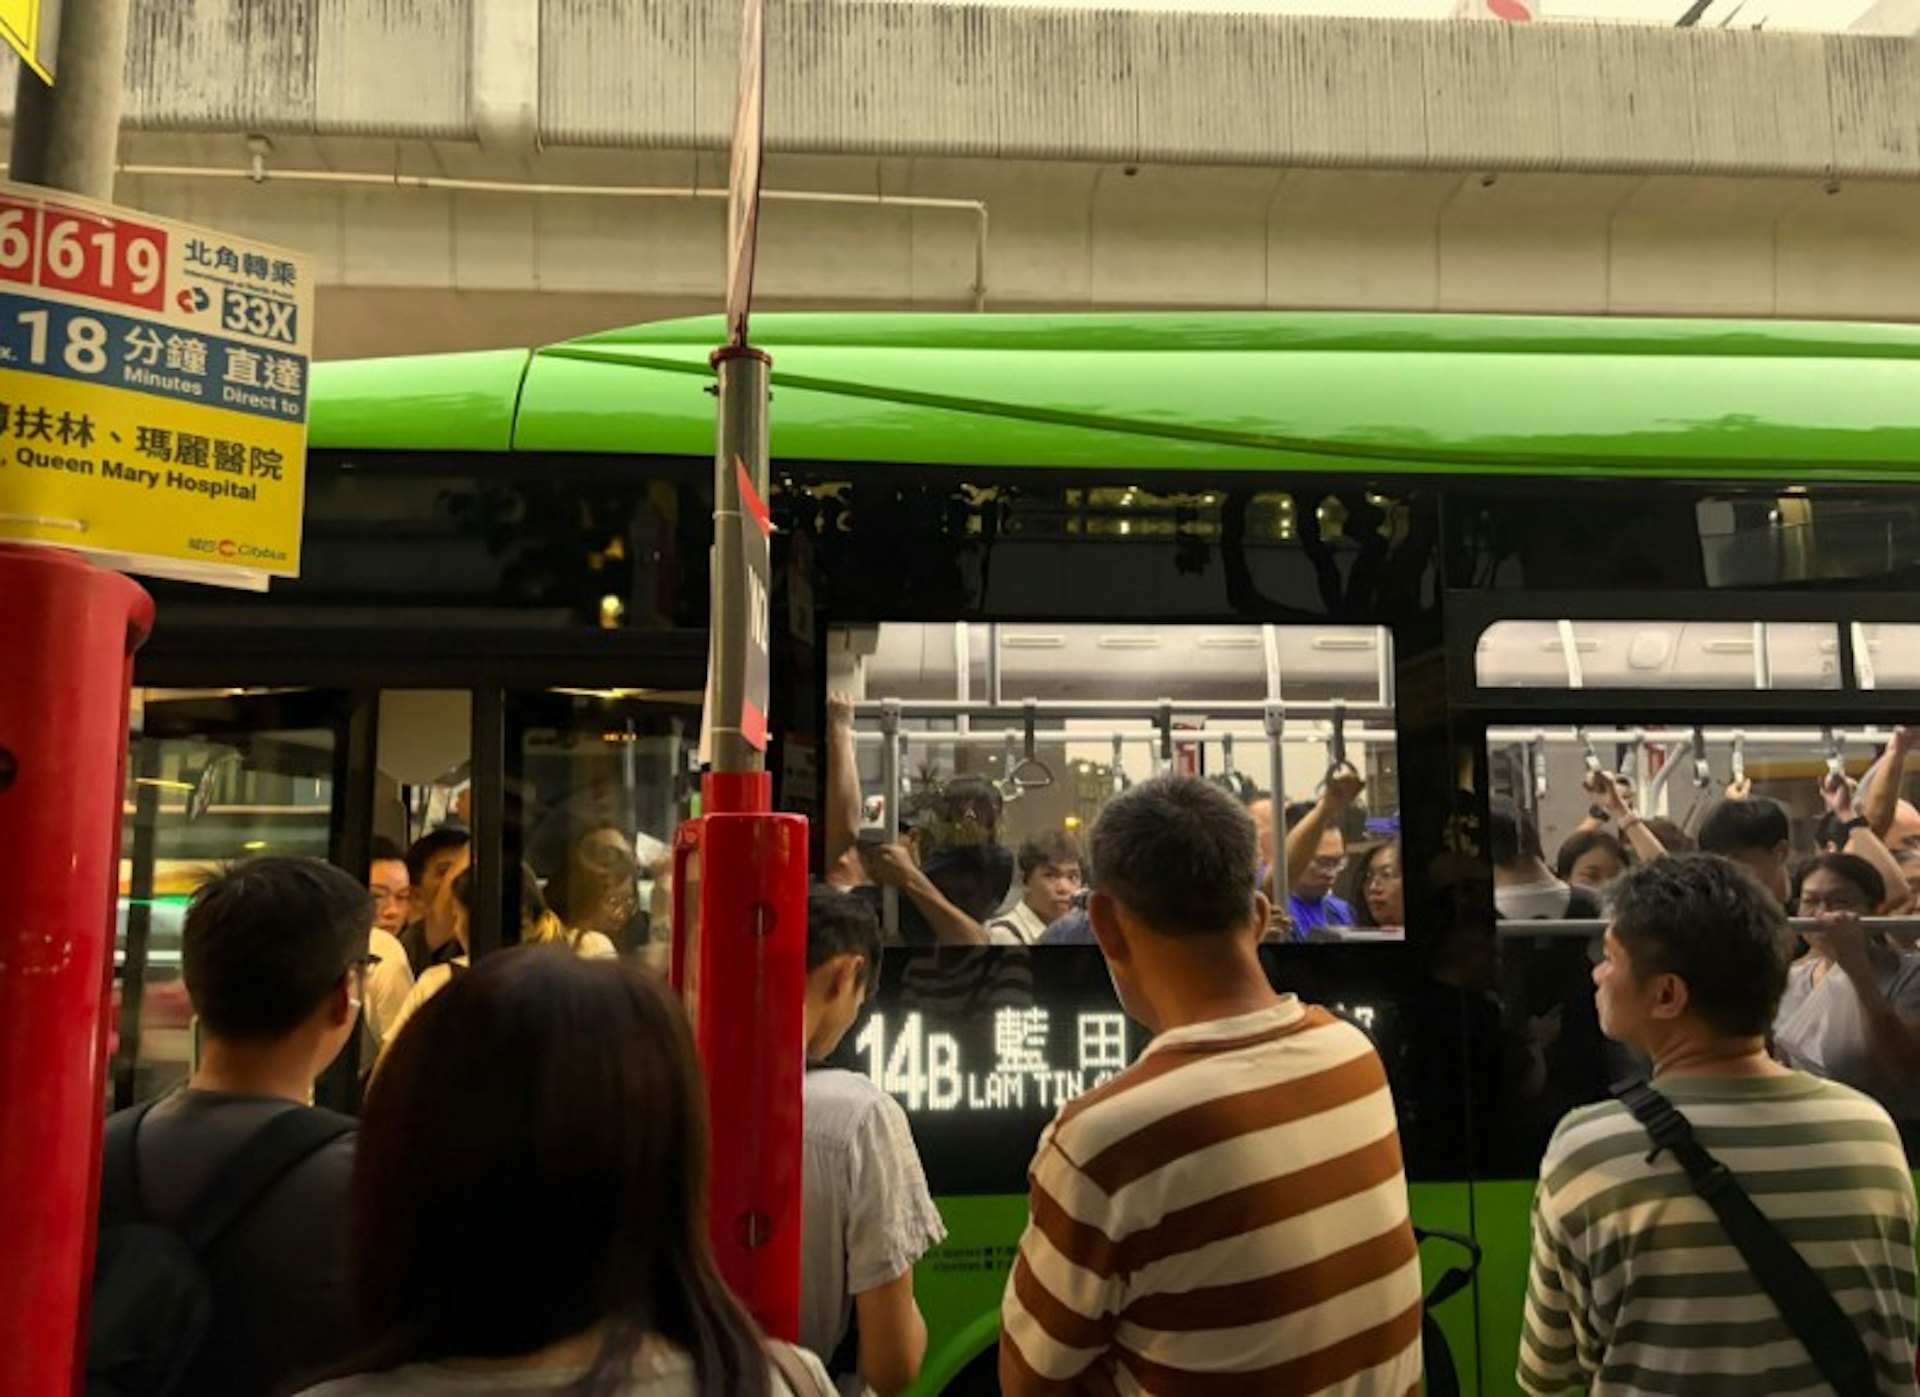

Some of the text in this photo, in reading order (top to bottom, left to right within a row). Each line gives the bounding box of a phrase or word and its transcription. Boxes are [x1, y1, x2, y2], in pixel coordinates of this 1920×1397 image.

[47, 220, 160, 295] 619
[184, 239, 297, 287] 北角轉乘
[225, 292, 294, 342] 33X
[18, 310, 107, 374] 18
[123, 325, 207, 376] 分鐘
[223, 346, 301, 396] 直達
[123, 365, 203, 396] Minutes
[223, 386, 299, 415] Direct to
[16, 446, 256, 501] Queen Mary Hospital
[855, 1011, 962, 1111] 14B
[967, 1071, 1024, 1110] LAM
[1033, 1070, 1084, 1109] TIN
